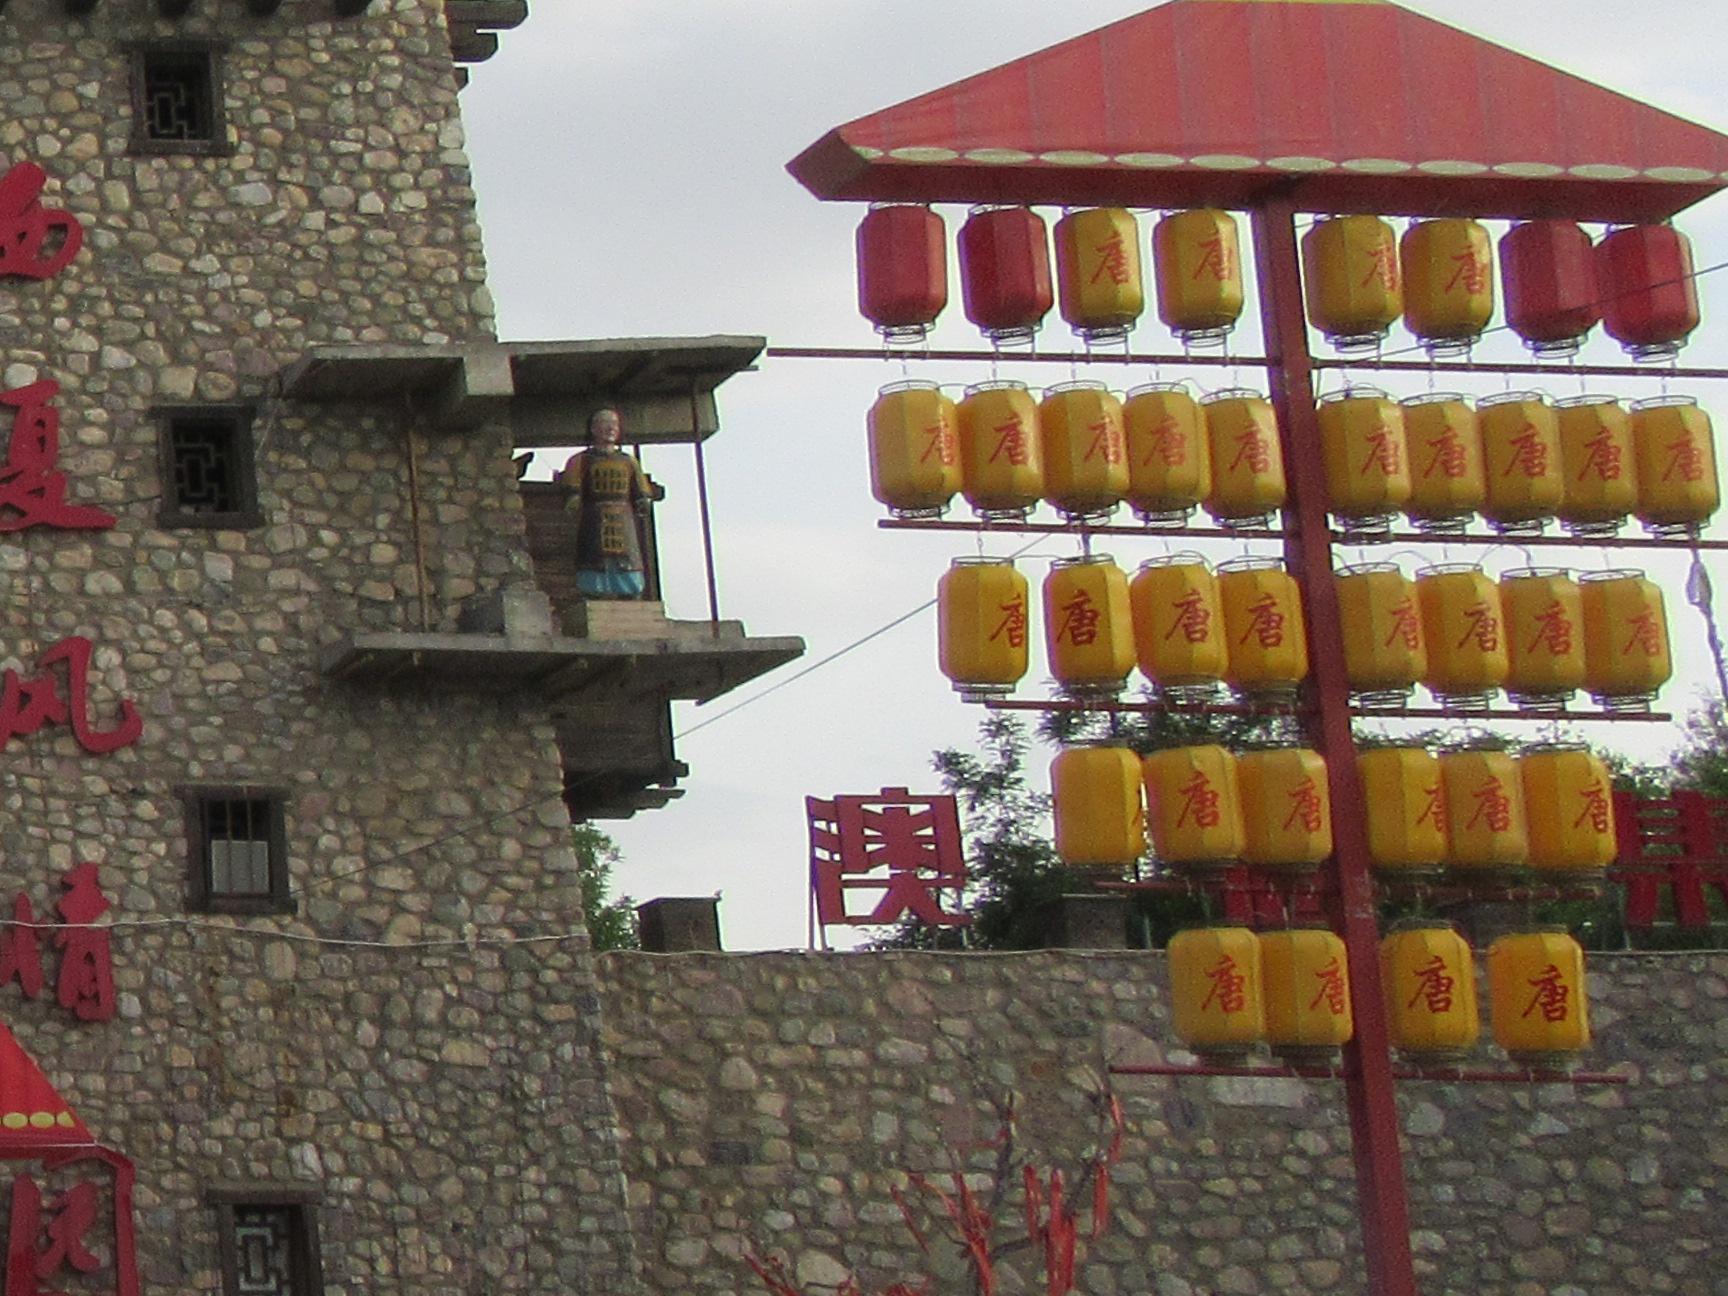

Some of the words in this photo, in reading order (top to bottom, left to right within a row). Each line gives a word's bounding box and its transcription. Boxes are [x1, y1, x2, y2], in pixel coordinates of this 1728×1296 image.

[1090, 231, 1131, 286] 唐
[1193, 230, 1232, 281] 唐
[1362, 245, 1398, 292] 唐
[1445, 245, 1487, 295] 唐
[920, 415, 957, 467] 唐
[989, 411, 1030, 466] 唐
[1084, 412, 1122, 465] 唐
[1144, 415, 1188, 467] 唐
[1229, 419, 1270, 474] 唐
[1361, 424, 1400, 477] 唐
[1424, 425, 1466, 479] 唐
[1504, 421, 1546, 479] 唐
[1578, 426, 1622, 482] 唐
[1662, 430, 1704, 483] 唐
[989, 593, 1025, 649] 唐
[1057, 589, 1101, 647] 唐
[1165, 589, 1211, 643] 唐
[1239, 592, 1285, 649] 唐
[1385, 598, 1423, 651] 唐
[1458, 602, 1498, 653] 唐
[1527, 601, 1573, 656] 唐
[1622, 608, 1660, 657] 唐
[1177, 770, 1221, 829] 唐
[1282, 776, 1321, 833] 唐
[1466, 776, 1510, 833] 唐
[1574, 778, 1609, 834] 唐
[1201, 953, 1244, 1014] 唐
[1310, 956, 1344, 1015] 唐
[1408, 956, 1454, 1014] 唐
[1522, 963, 1569, 1023] 唐
